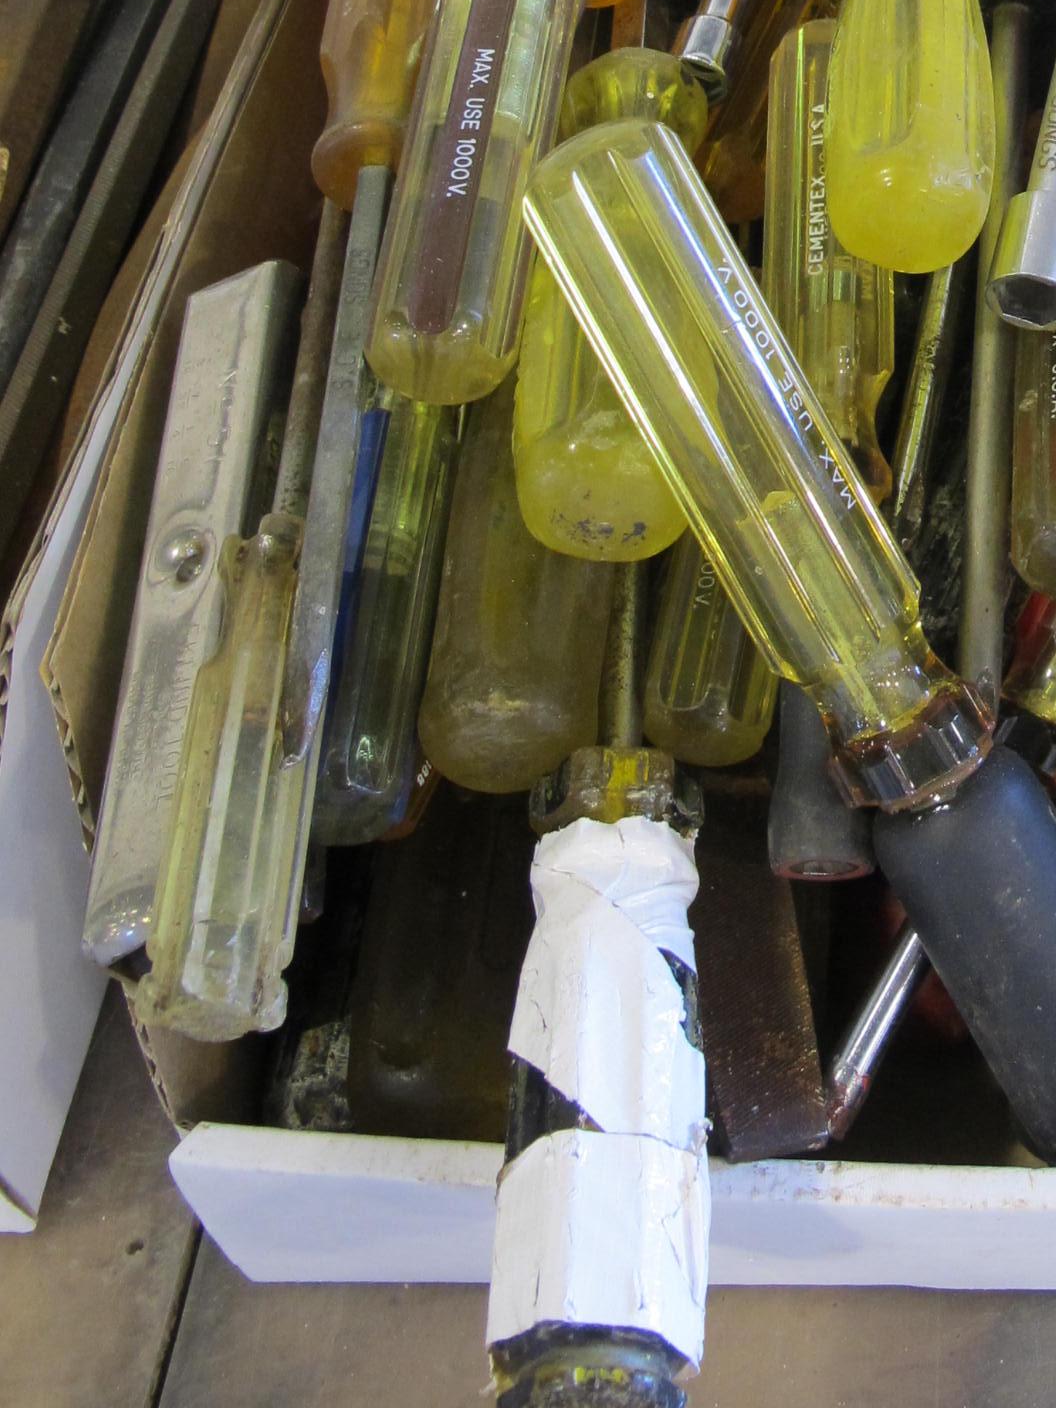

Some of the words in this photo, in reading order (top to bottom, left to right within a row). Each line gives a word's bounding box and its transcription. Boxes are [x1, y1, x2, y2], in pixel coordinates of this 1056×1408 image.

[469, 48, 496, 89] MAX.
[460, 98, 486, 131] USE
[807, 174, 827, 277] CEMENTEX
[777, 370, 814, 432] USE
